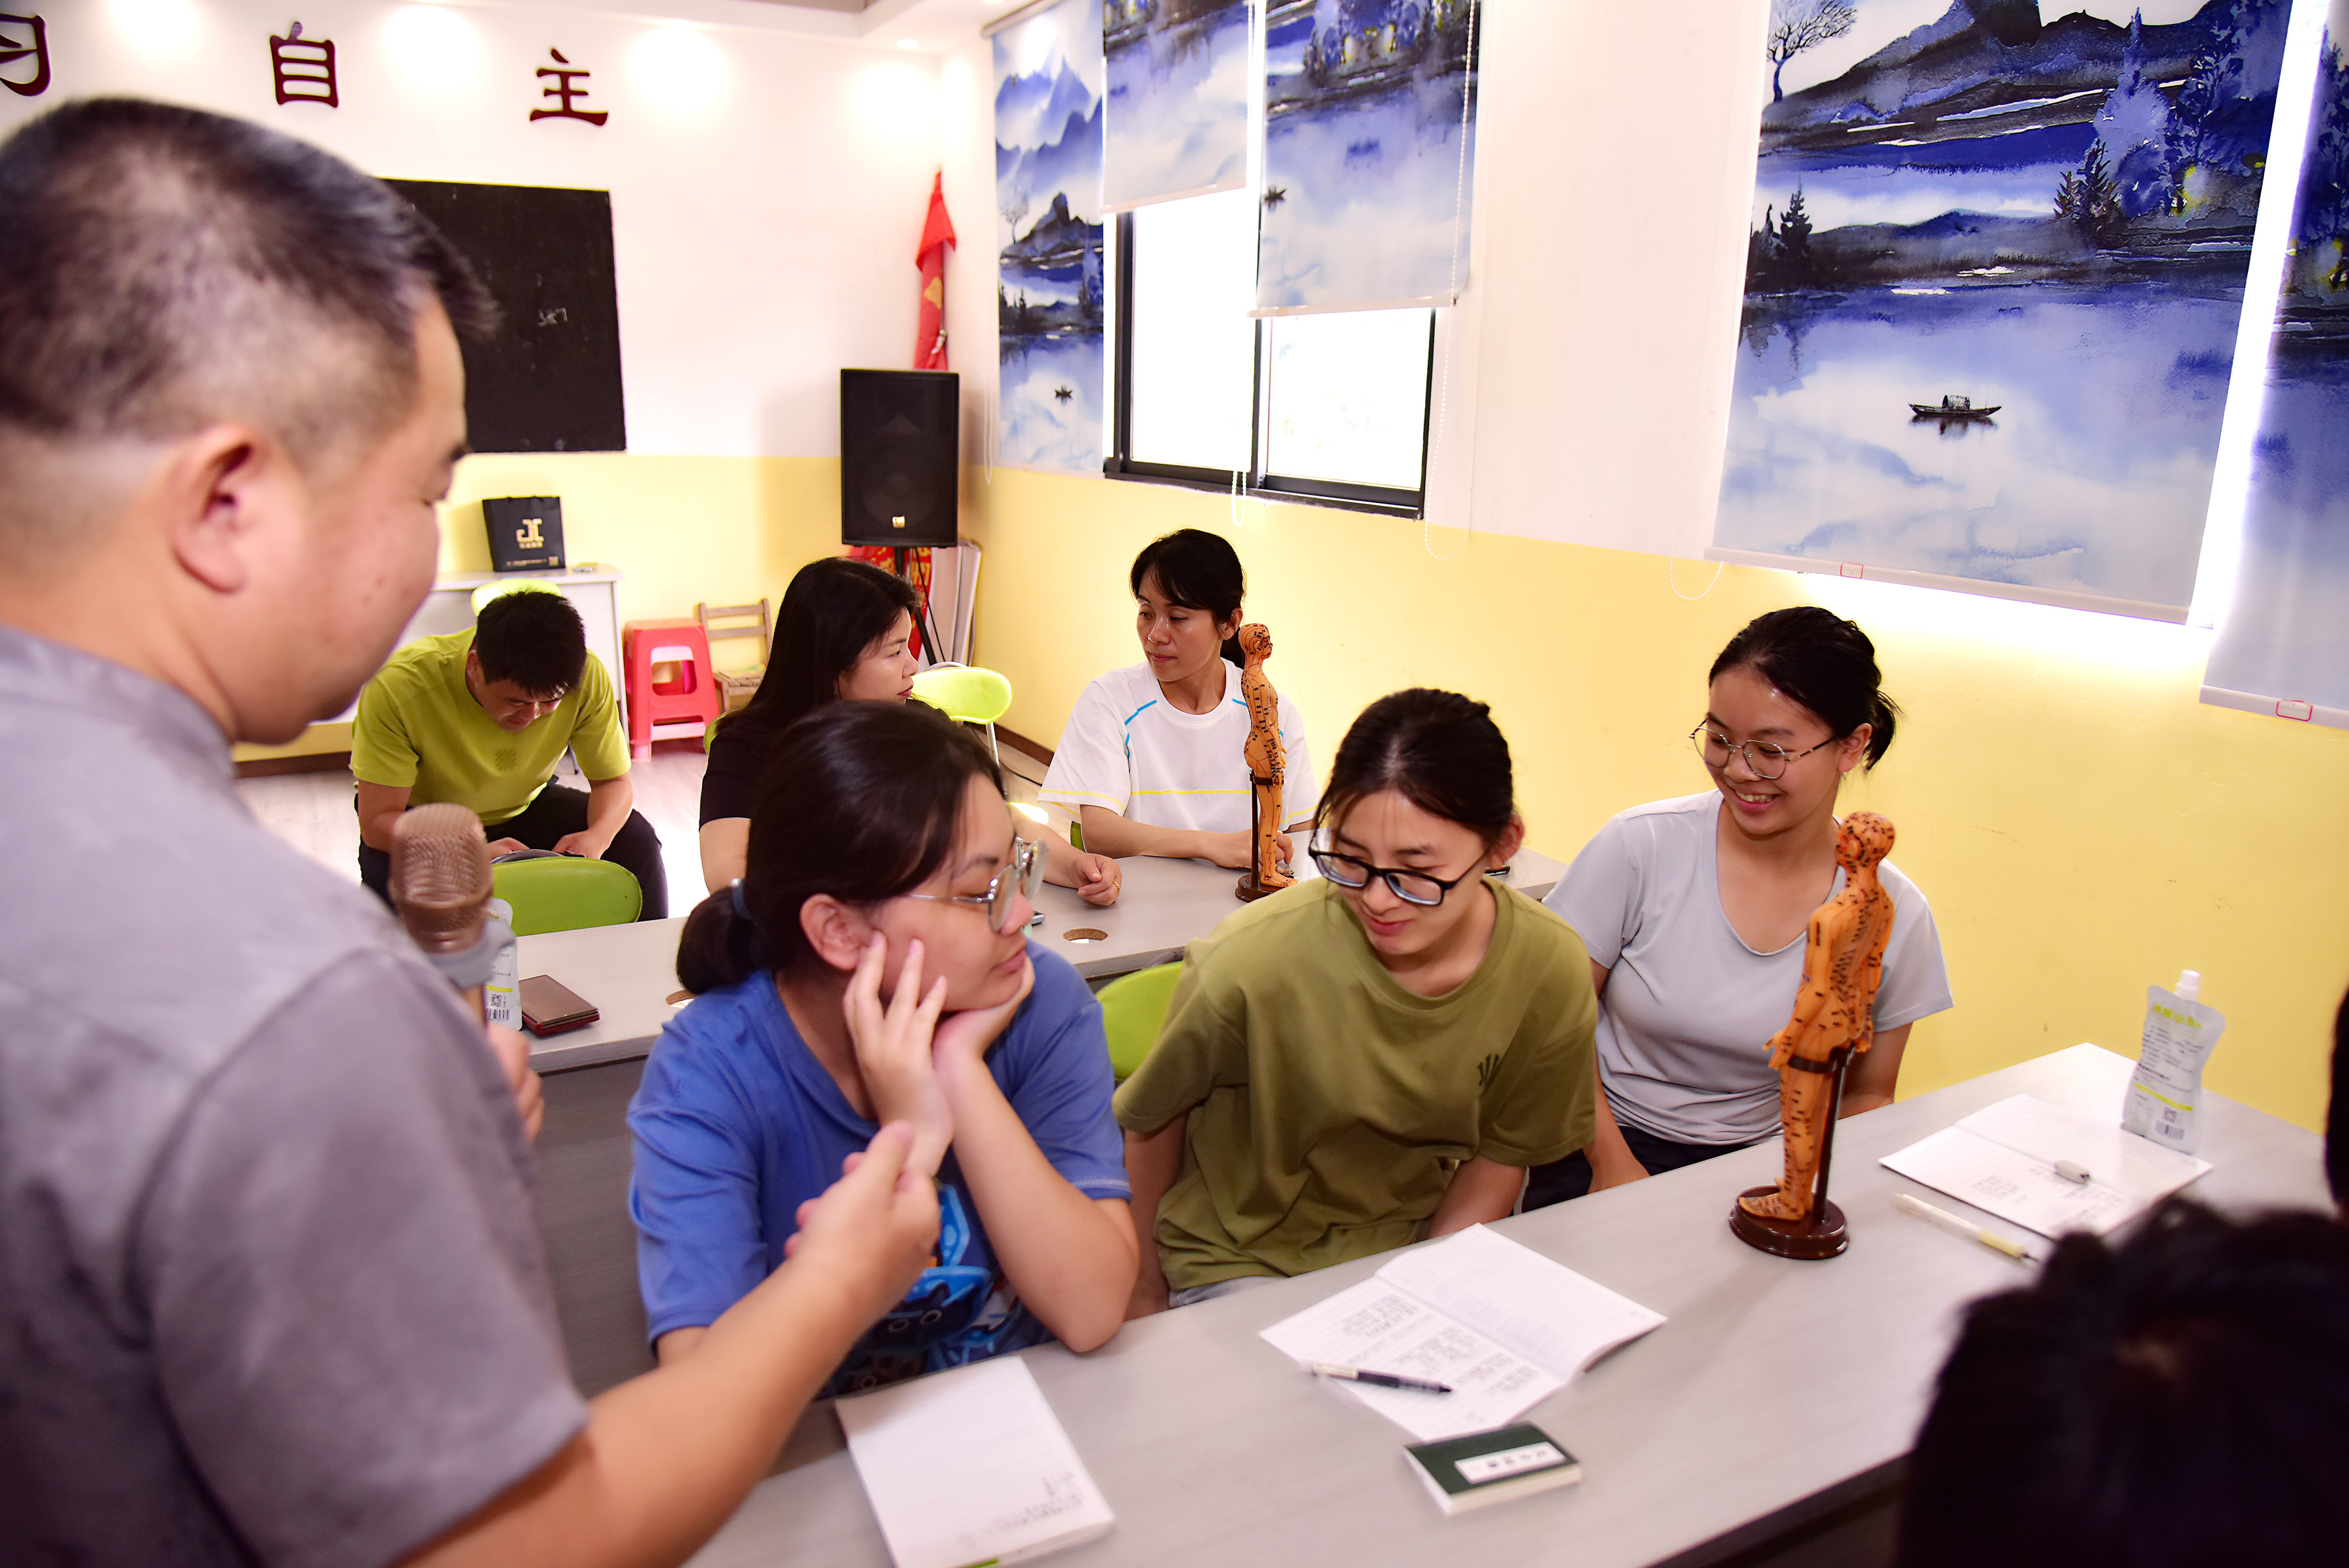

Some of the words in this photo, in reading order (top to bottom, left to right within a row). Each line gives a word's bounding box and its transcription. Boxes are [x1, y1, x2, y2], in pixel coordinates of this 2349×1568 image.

[0, 13, 51, 97] 习
[269, 21, 339, 108] 自
[529, 48, 609, 126] 主
